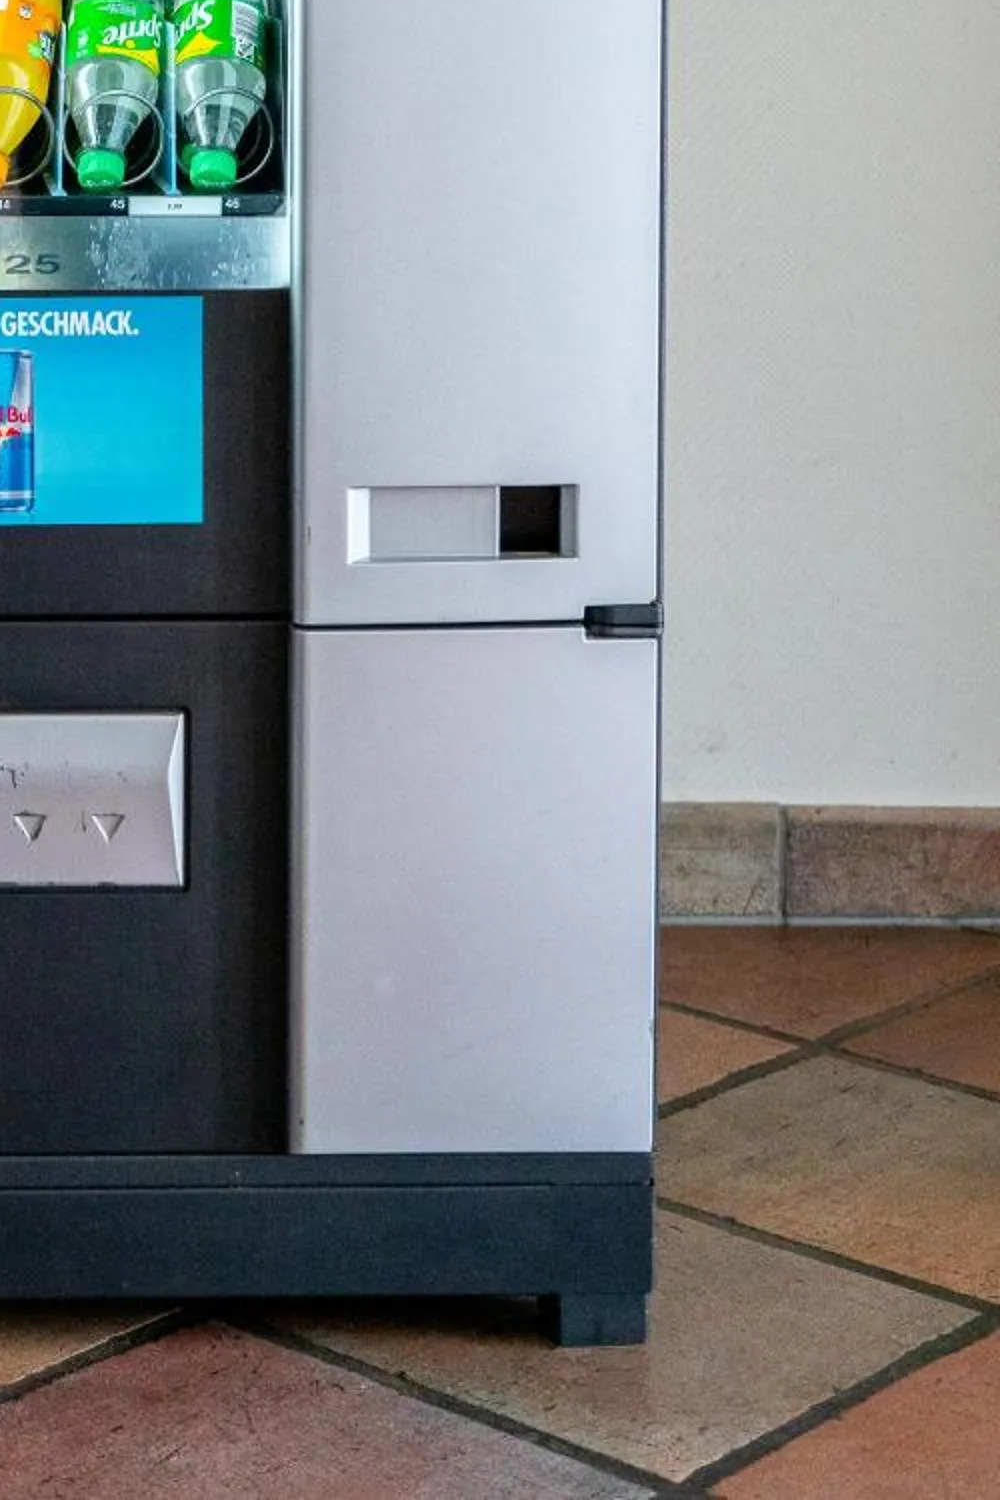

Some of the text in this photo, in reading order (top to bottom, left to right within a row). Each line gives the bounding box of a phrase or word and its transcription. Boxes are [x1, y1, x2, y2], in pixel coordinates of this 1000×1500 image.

[103, 14, 160, 48] Sprite
[110, 200, 125, 210] 45
[225, 199, 240, 210] 46
[5, 254, 61, 275] 25
[1, 310, 139, 337] GESCHMACK.
